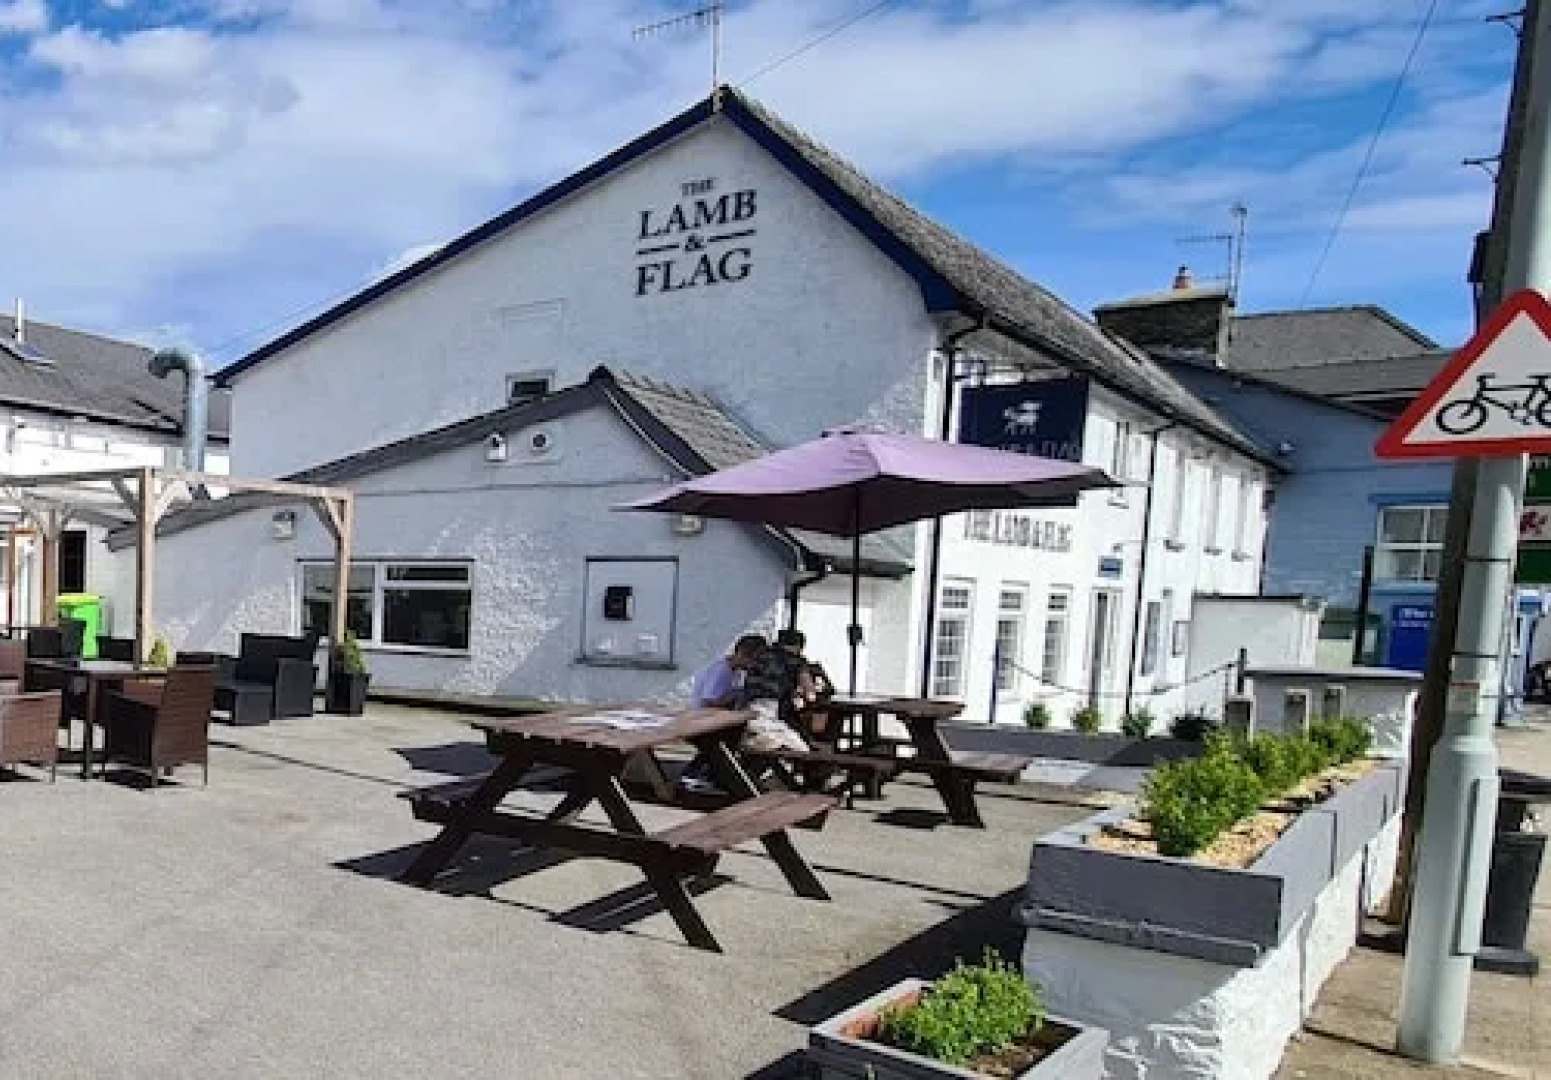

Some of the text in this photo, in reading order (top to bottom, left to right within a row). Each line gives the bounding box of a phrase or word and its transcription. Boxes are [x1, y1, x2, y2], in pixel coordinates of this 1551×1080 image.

[680, 178, 714, 196] THE
[637, 189, 757, 240] LAMB
[684, 235, 707, 252] &
[634, 248, 753, 297] FLAG
